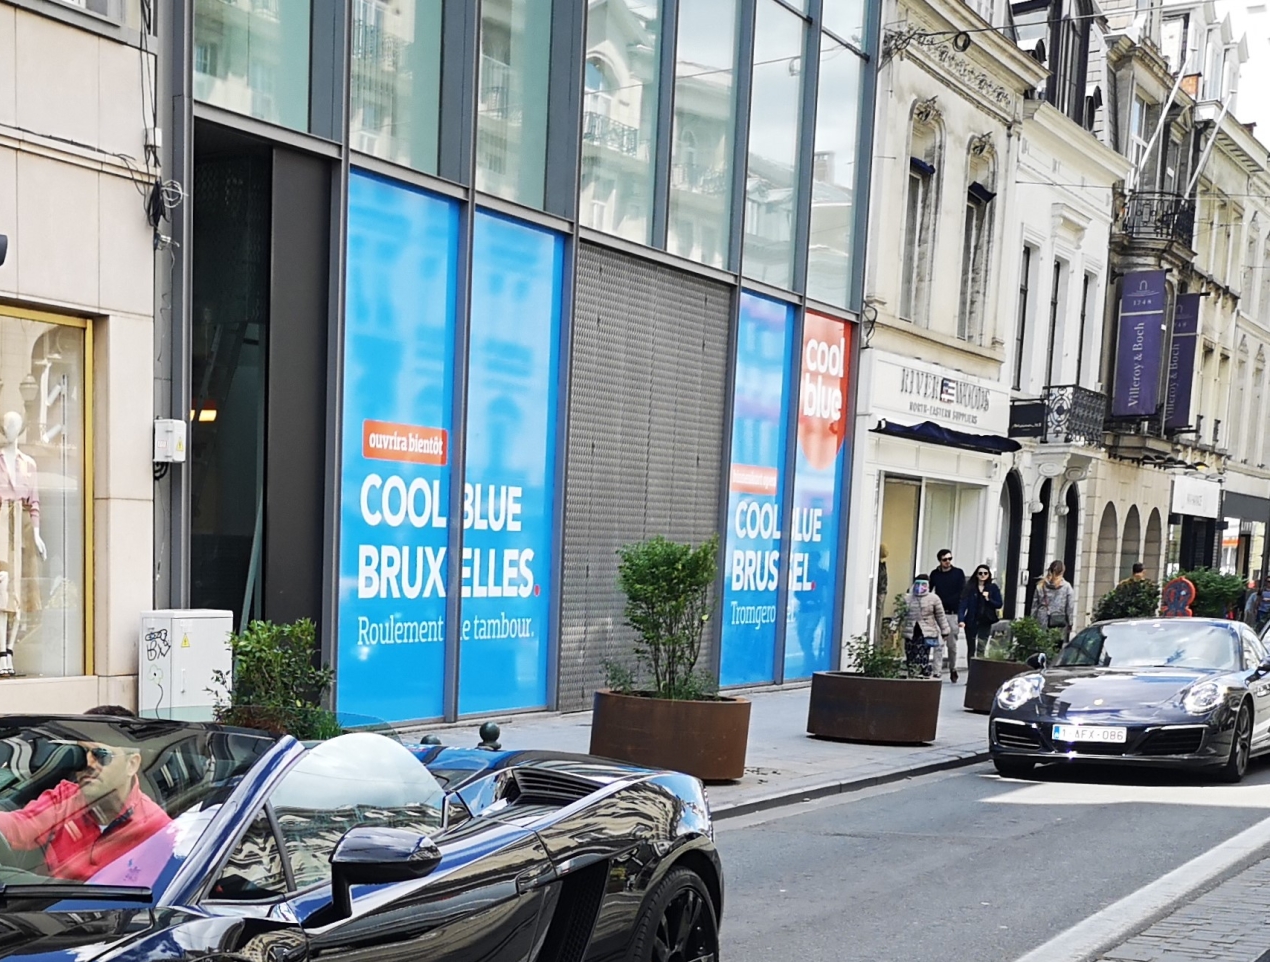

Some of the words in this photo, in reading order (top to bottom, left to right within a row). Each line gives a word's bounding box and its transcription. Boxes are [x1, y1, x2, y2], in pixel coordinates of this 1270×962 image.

[1132, 322, 1145, 351] Boch
[805, 337, 845, 378] cool
[1133, 353, 1143, 361] &
[802, 372, 843, 421] blue
[1128, 363, 1144, 407] Villeroy
[368, 431, 408, 452] ouvrira
[408, 432, 444, 456] bientôt
[791, 507, 823, 543] LUE
[357, 615, 444, 646] Roulement
[473, 612, 534, 639] tambour.
